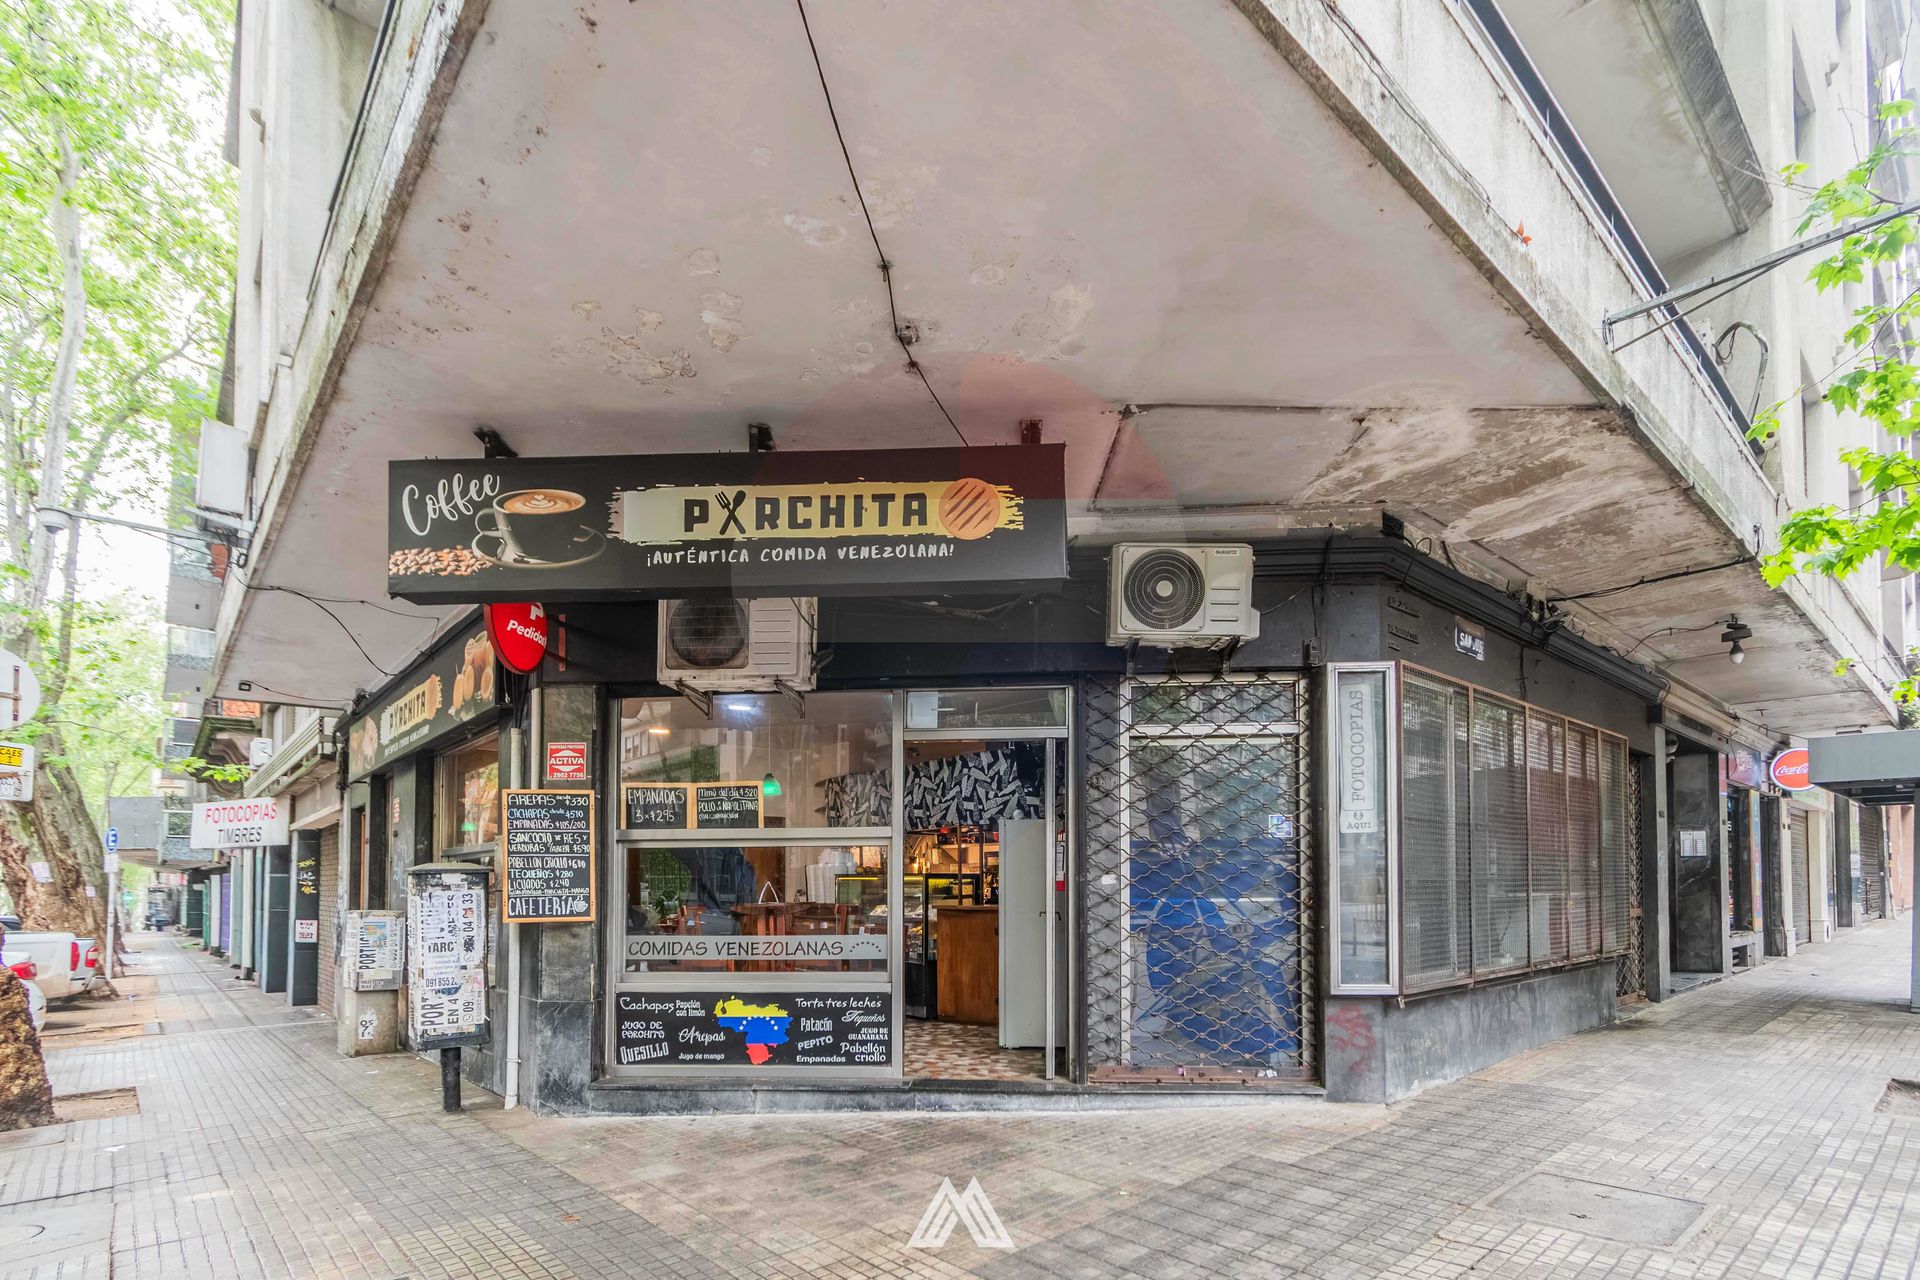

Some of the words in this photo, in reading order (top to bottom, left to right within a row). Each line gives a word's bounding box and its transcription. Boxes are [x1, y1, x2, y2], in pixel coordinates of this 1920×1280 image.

[402, 473, 500, 536] Coffee
[647, 547, 749, 567] ¡AUTÉNTICA
[760, 547, 827, 562] COMIDA
[837, 544, 955, 560] VENEZOLANA!
[1459, 632, 1473, 649] SAN
[1349, 690, 1365, 803] FOTOCOPIAS
[549, 757, 584, 765] ACTIVA
[627, 788, 685, 805] EMPANADAS
[719, 788, 728, 797] del
[739, 788, 758, 798] $320
[508, 794, 556, 806] AREPAS
[565, 797, 589, 806] $330
[205, 802, 278, 824] FOTOCOPIAS
[508, 808, 550, 819] CACHAPAS
[565, 810, 584, 819] $510
[508, 820, 554, 830] EMPANADAS
[1346, 822, 1372, 831] AQUI
[218, 826, 262, 844] TIMBRES
[509, 832, 552, 844] SANCOCHO
[563, 833, 581, 844] RES
[508, 868, 554, 879] TEQUEÑOS
[508, 895, 576, 916] CAFETERÍA
[628, 941, 708, 956] COMIDAS
[715, 940, 844, 956] VENEZOLANAS
[619, 997, 675, 1014] Cachapas
[675, 1000, 700, 1009] Papelón
[795, 997, 824, 1009] Torta
[825, 998, 847, 1009] tres
[849, 996, 882, 1008] leches
[675, 1009, 687, 1017] con
[688, 1008, 706, 1017] limón
[841, 1009, 886, 1027] Tequeños
[621, 1021, 646, 1030] JUGO
[649, 1021, 663, 1030] DE
[800, 1017, 833, 1033] Patacón
[621, 1030, 665, 1039] PARCHITA
[678, 1026, 726, 1046] Arepas
[797, 1035, 834, 1051] PEPITO
[840, 1042, 886, 1054] Pabellón
[619, 1041, 669, 1065] QUESILLO
[678, 1053, 694, 1061] Jugo
[703, 1053, 725, 1061] mango
[854, 1051, 886, 1062] criollo
[796, 1055, 846, 1064] Empanadas
